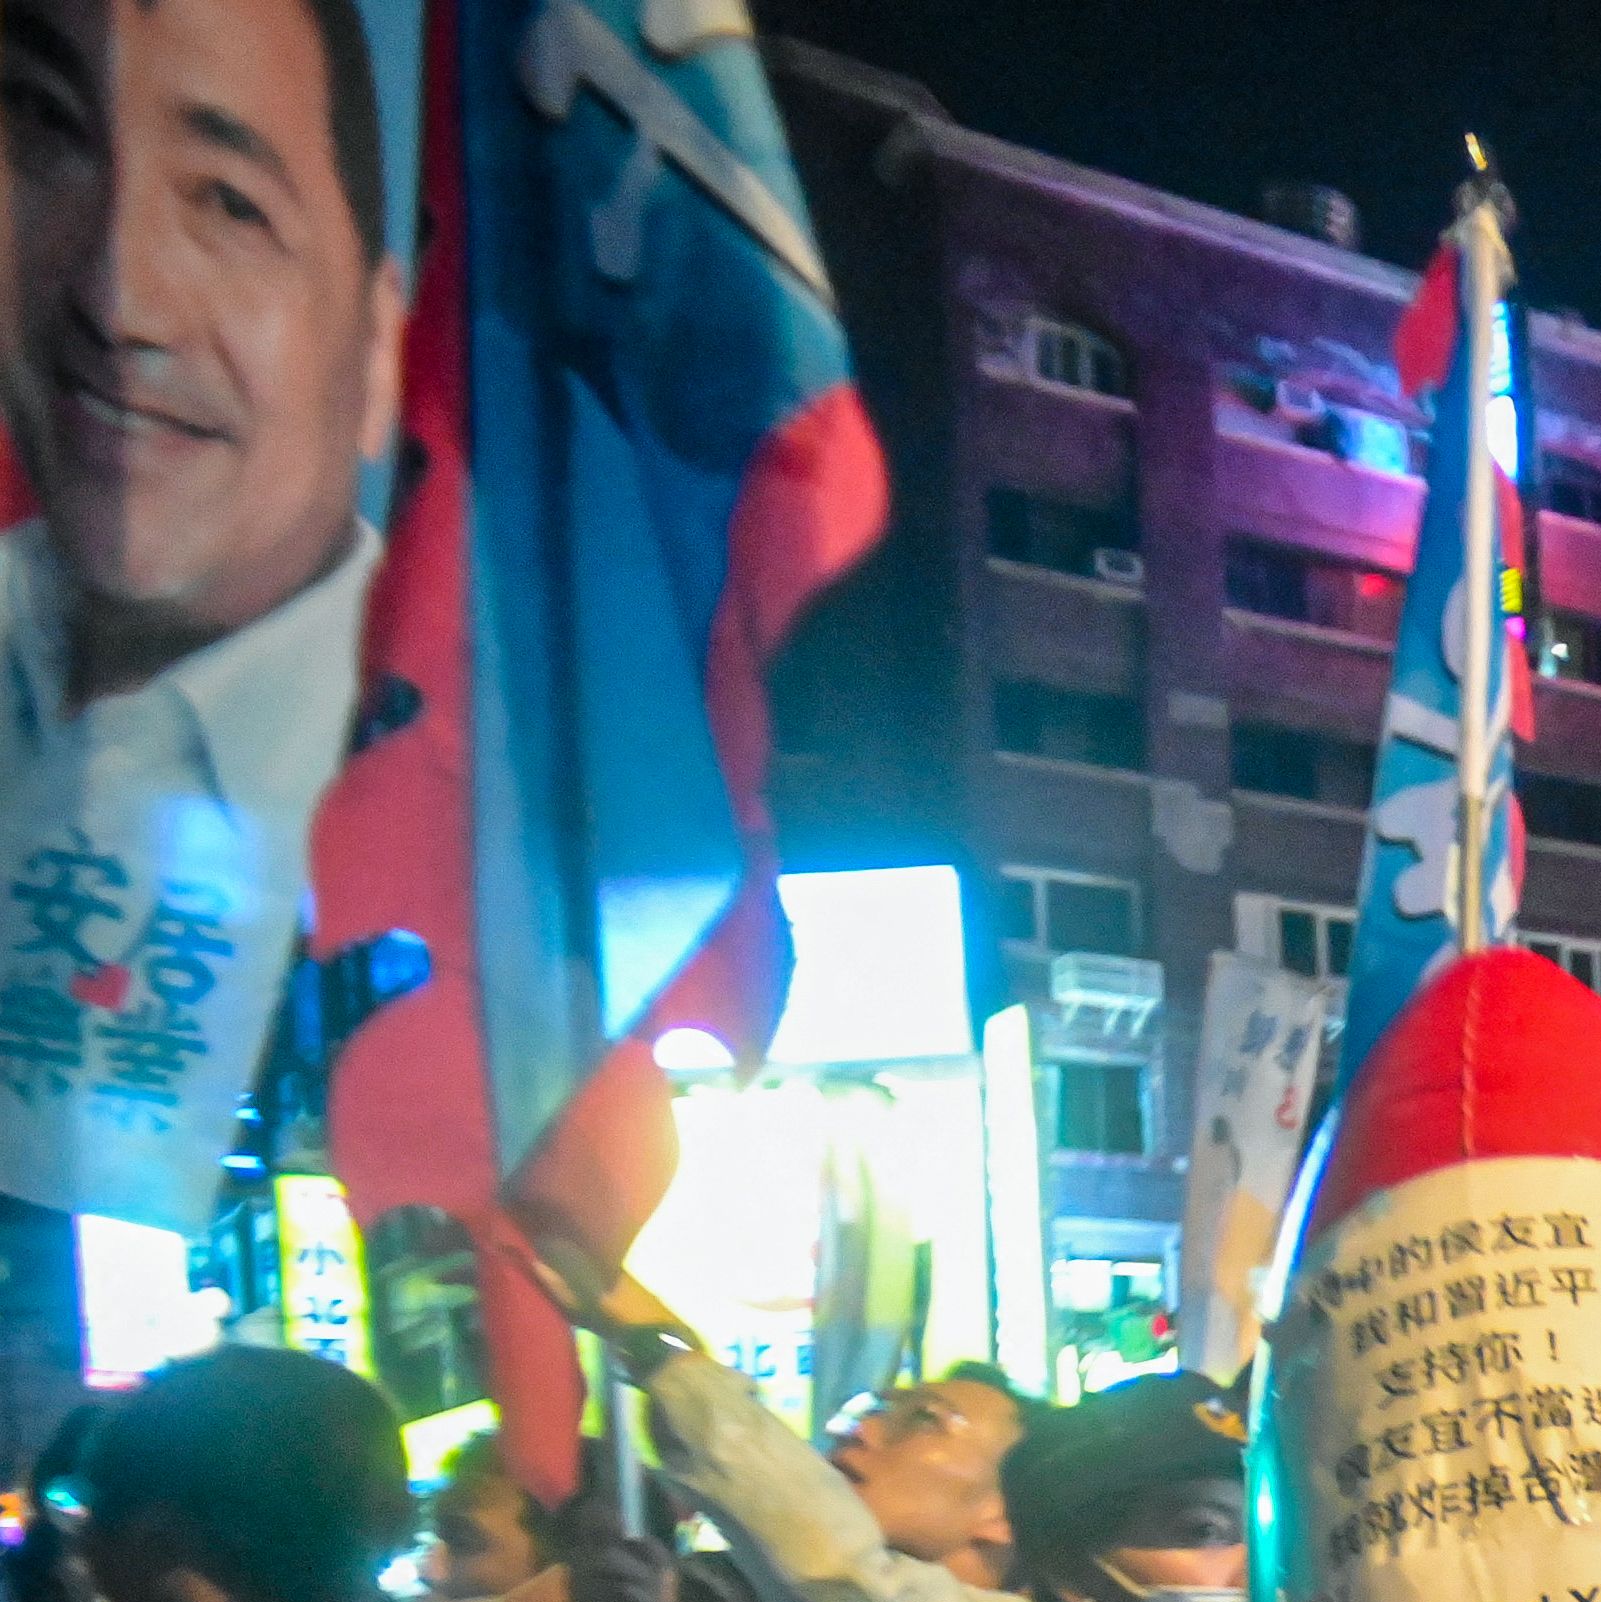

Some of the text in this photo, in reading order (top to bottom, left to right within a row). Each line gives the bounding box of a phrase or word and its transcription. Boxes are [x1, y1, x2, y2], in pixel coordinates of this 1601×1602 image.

[1350, 1267, 1598, 1357] 我和習近平
